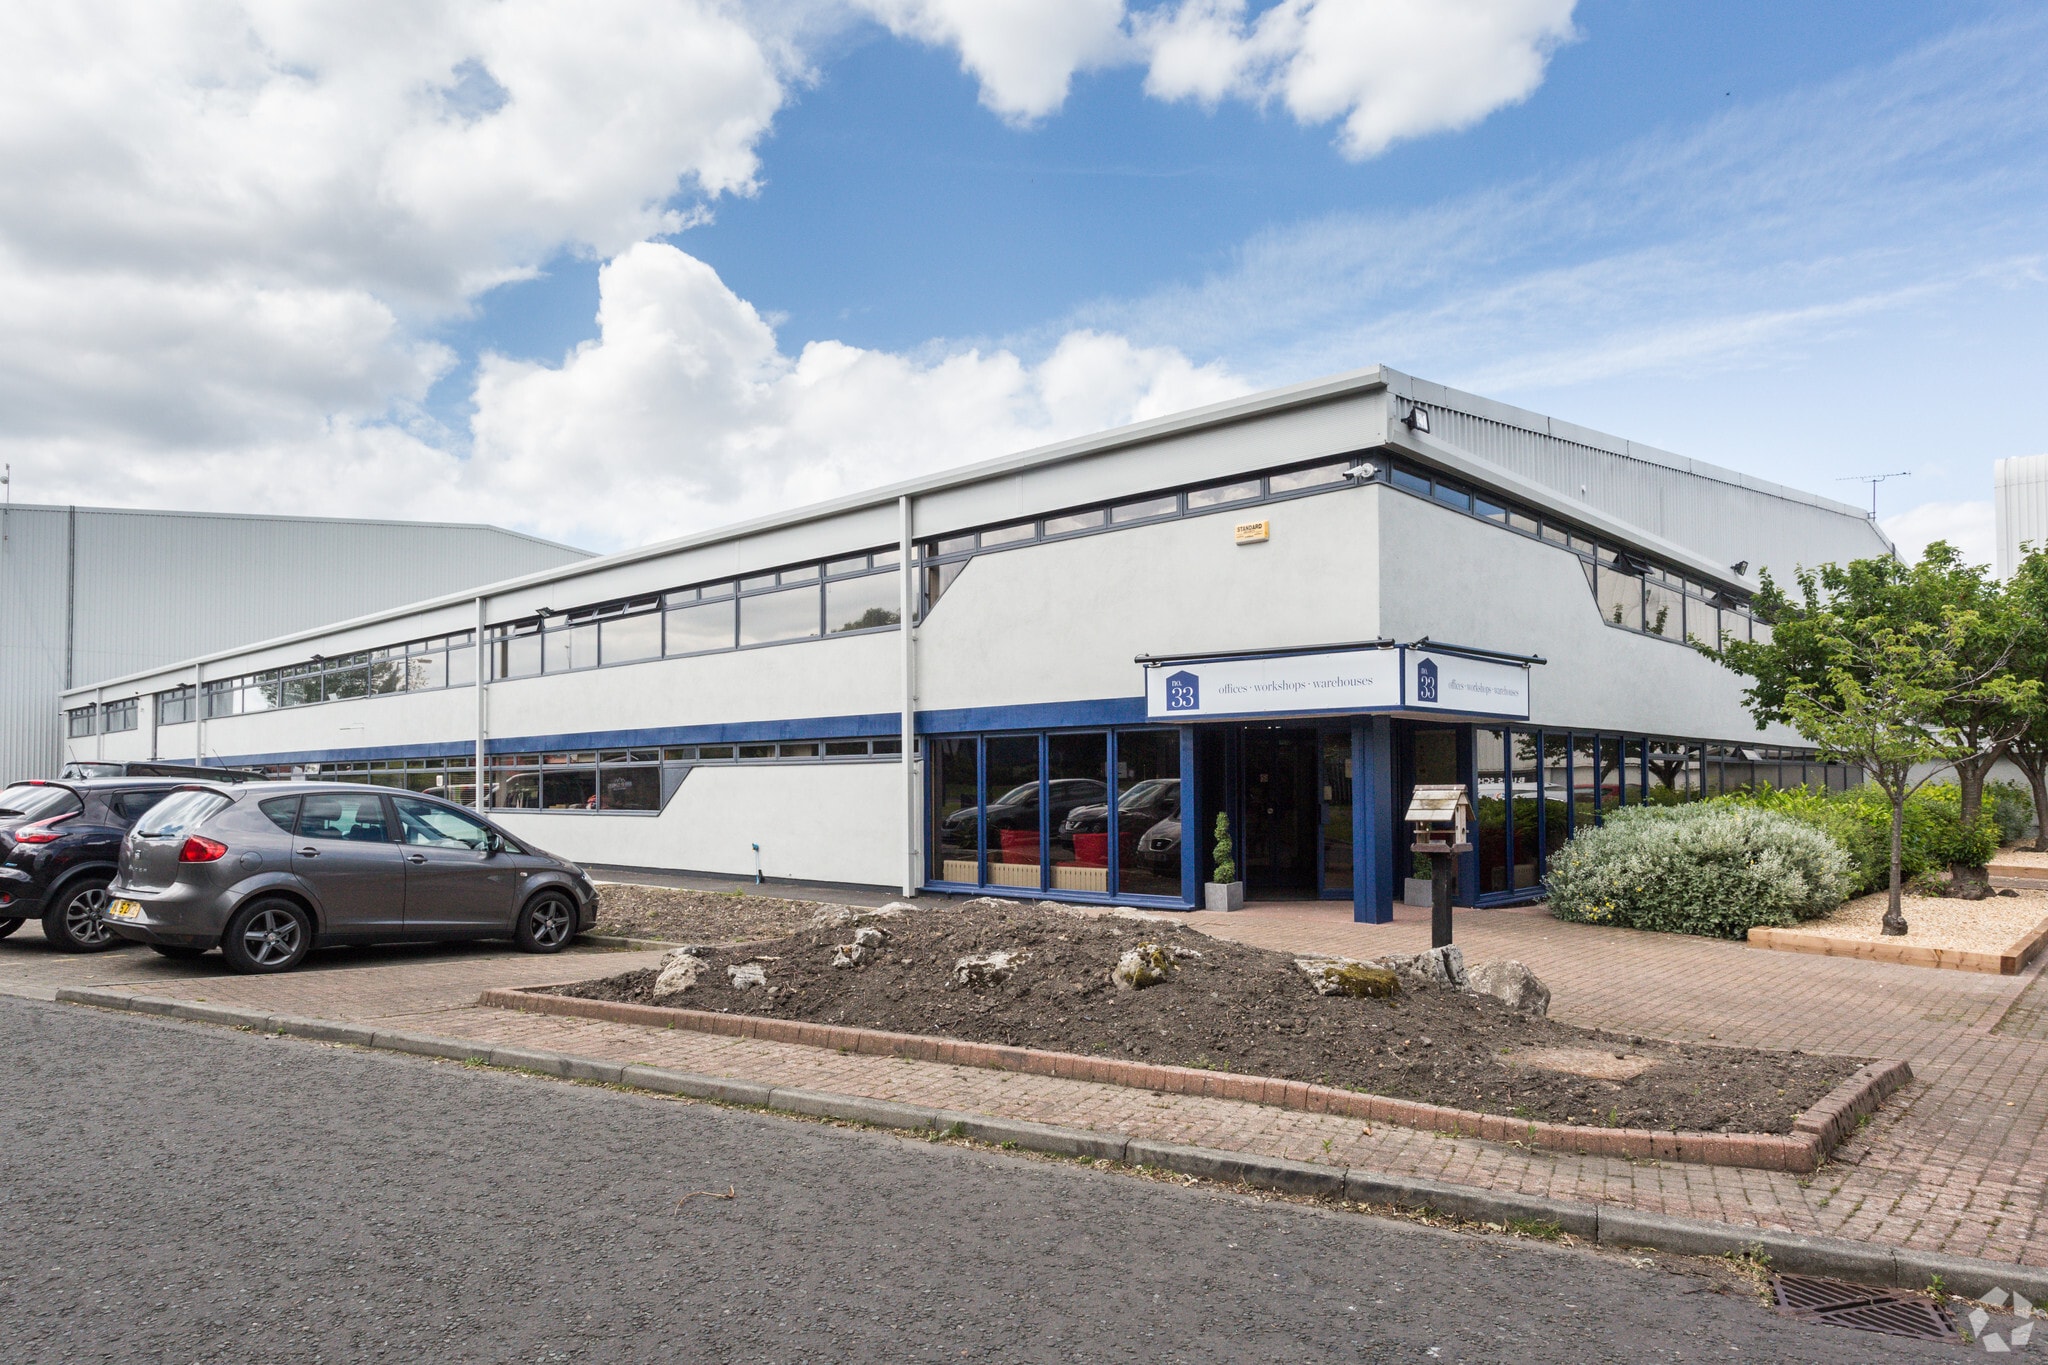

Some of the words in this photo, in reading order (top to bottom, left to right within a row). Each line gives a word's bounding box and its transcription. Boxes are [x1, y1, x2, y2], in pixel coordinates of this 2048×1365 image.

[1218, 682, 1248, 694] offices
[1254, 680, 1306, 693] workshops
[1312, 676, 1374, 689] warehouses
[1421, 676, 1435, 698] 33
[1171, 687, 1194, 707] 33
